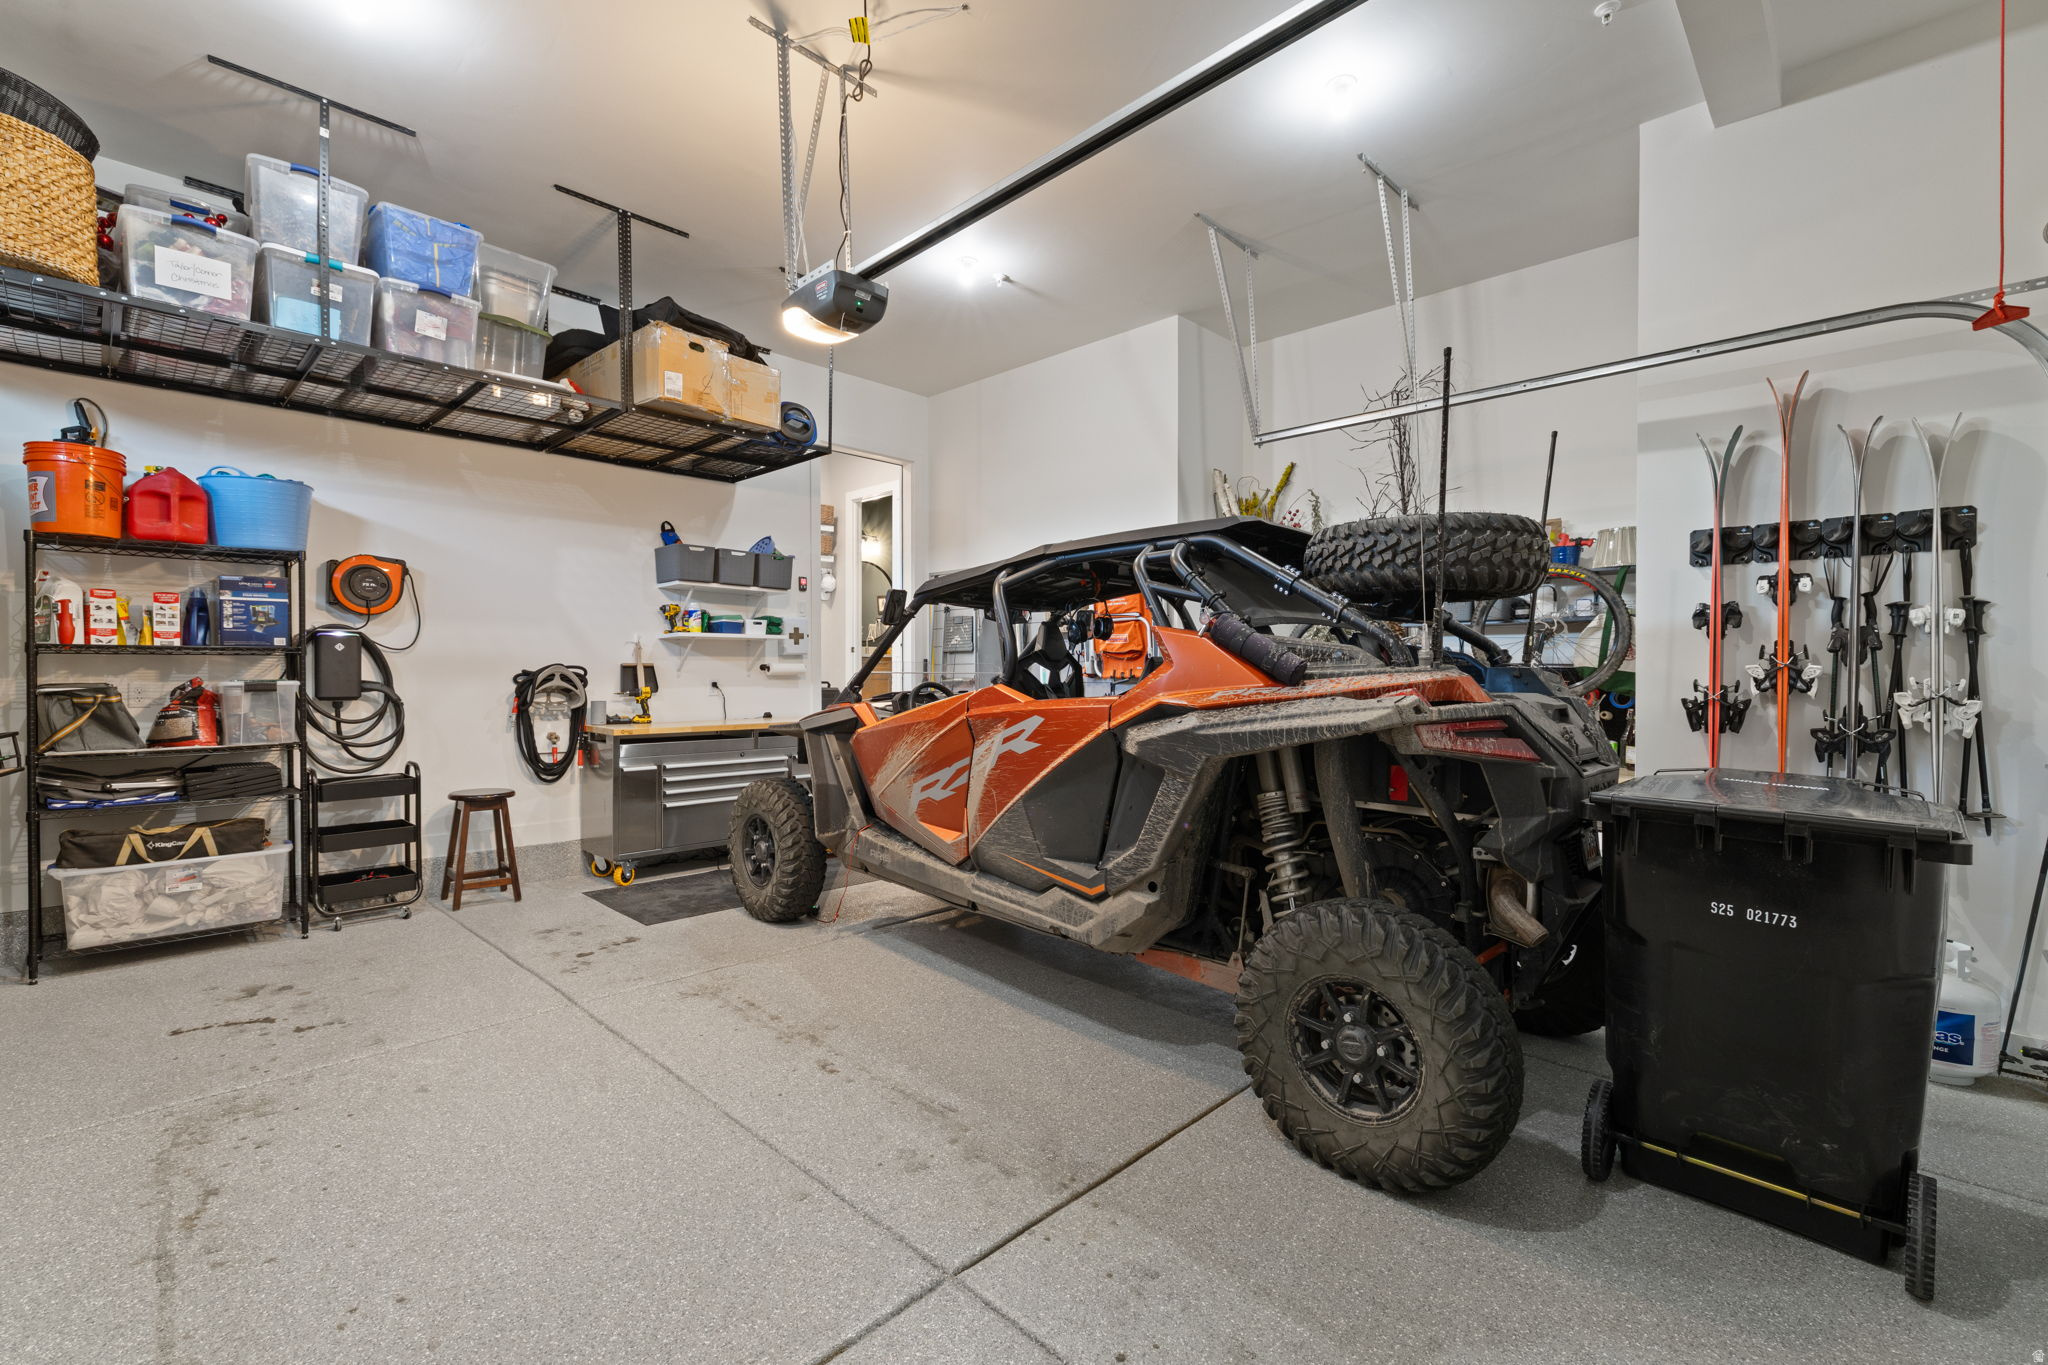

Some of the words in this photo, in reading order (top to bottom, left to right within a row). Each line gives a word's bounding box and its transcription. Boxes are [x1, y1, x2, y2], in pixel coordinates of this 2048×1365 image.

[909, 715, 1045, 818] RZR
[1710, 901, 1734, 917] S25
[1746, 908, 1797, 928] 021773
